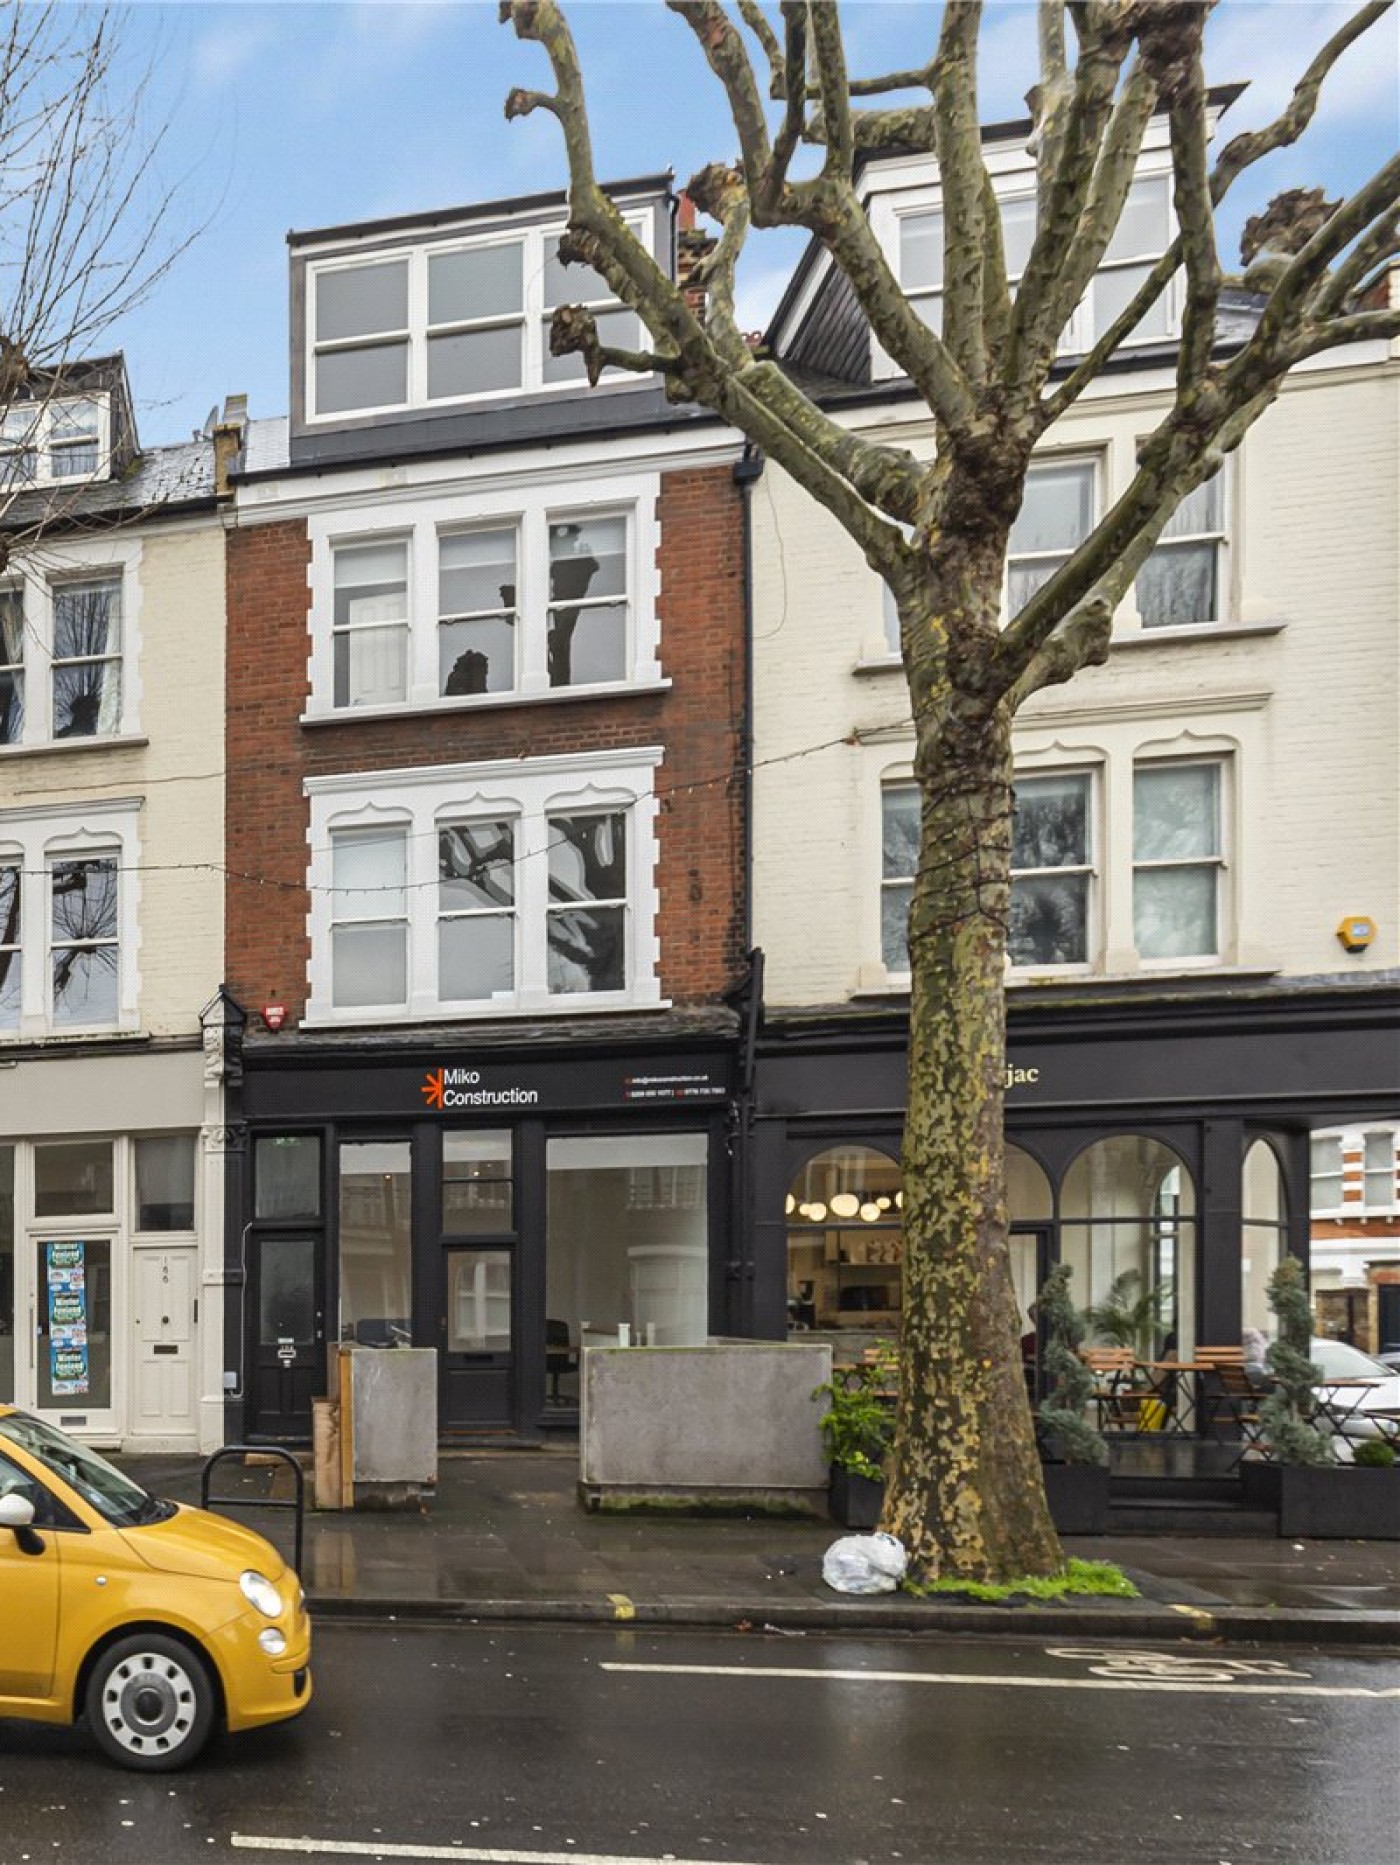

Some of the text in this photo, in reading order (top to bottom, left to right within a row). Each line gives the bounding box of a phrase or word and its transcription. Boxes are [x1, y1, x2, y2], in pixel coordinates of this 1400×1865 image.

[444, 1069, 480, 1085] Miko
[1004, 1063, 1039, 1088] jac
[444, 1088, 538, 1106] Construction
